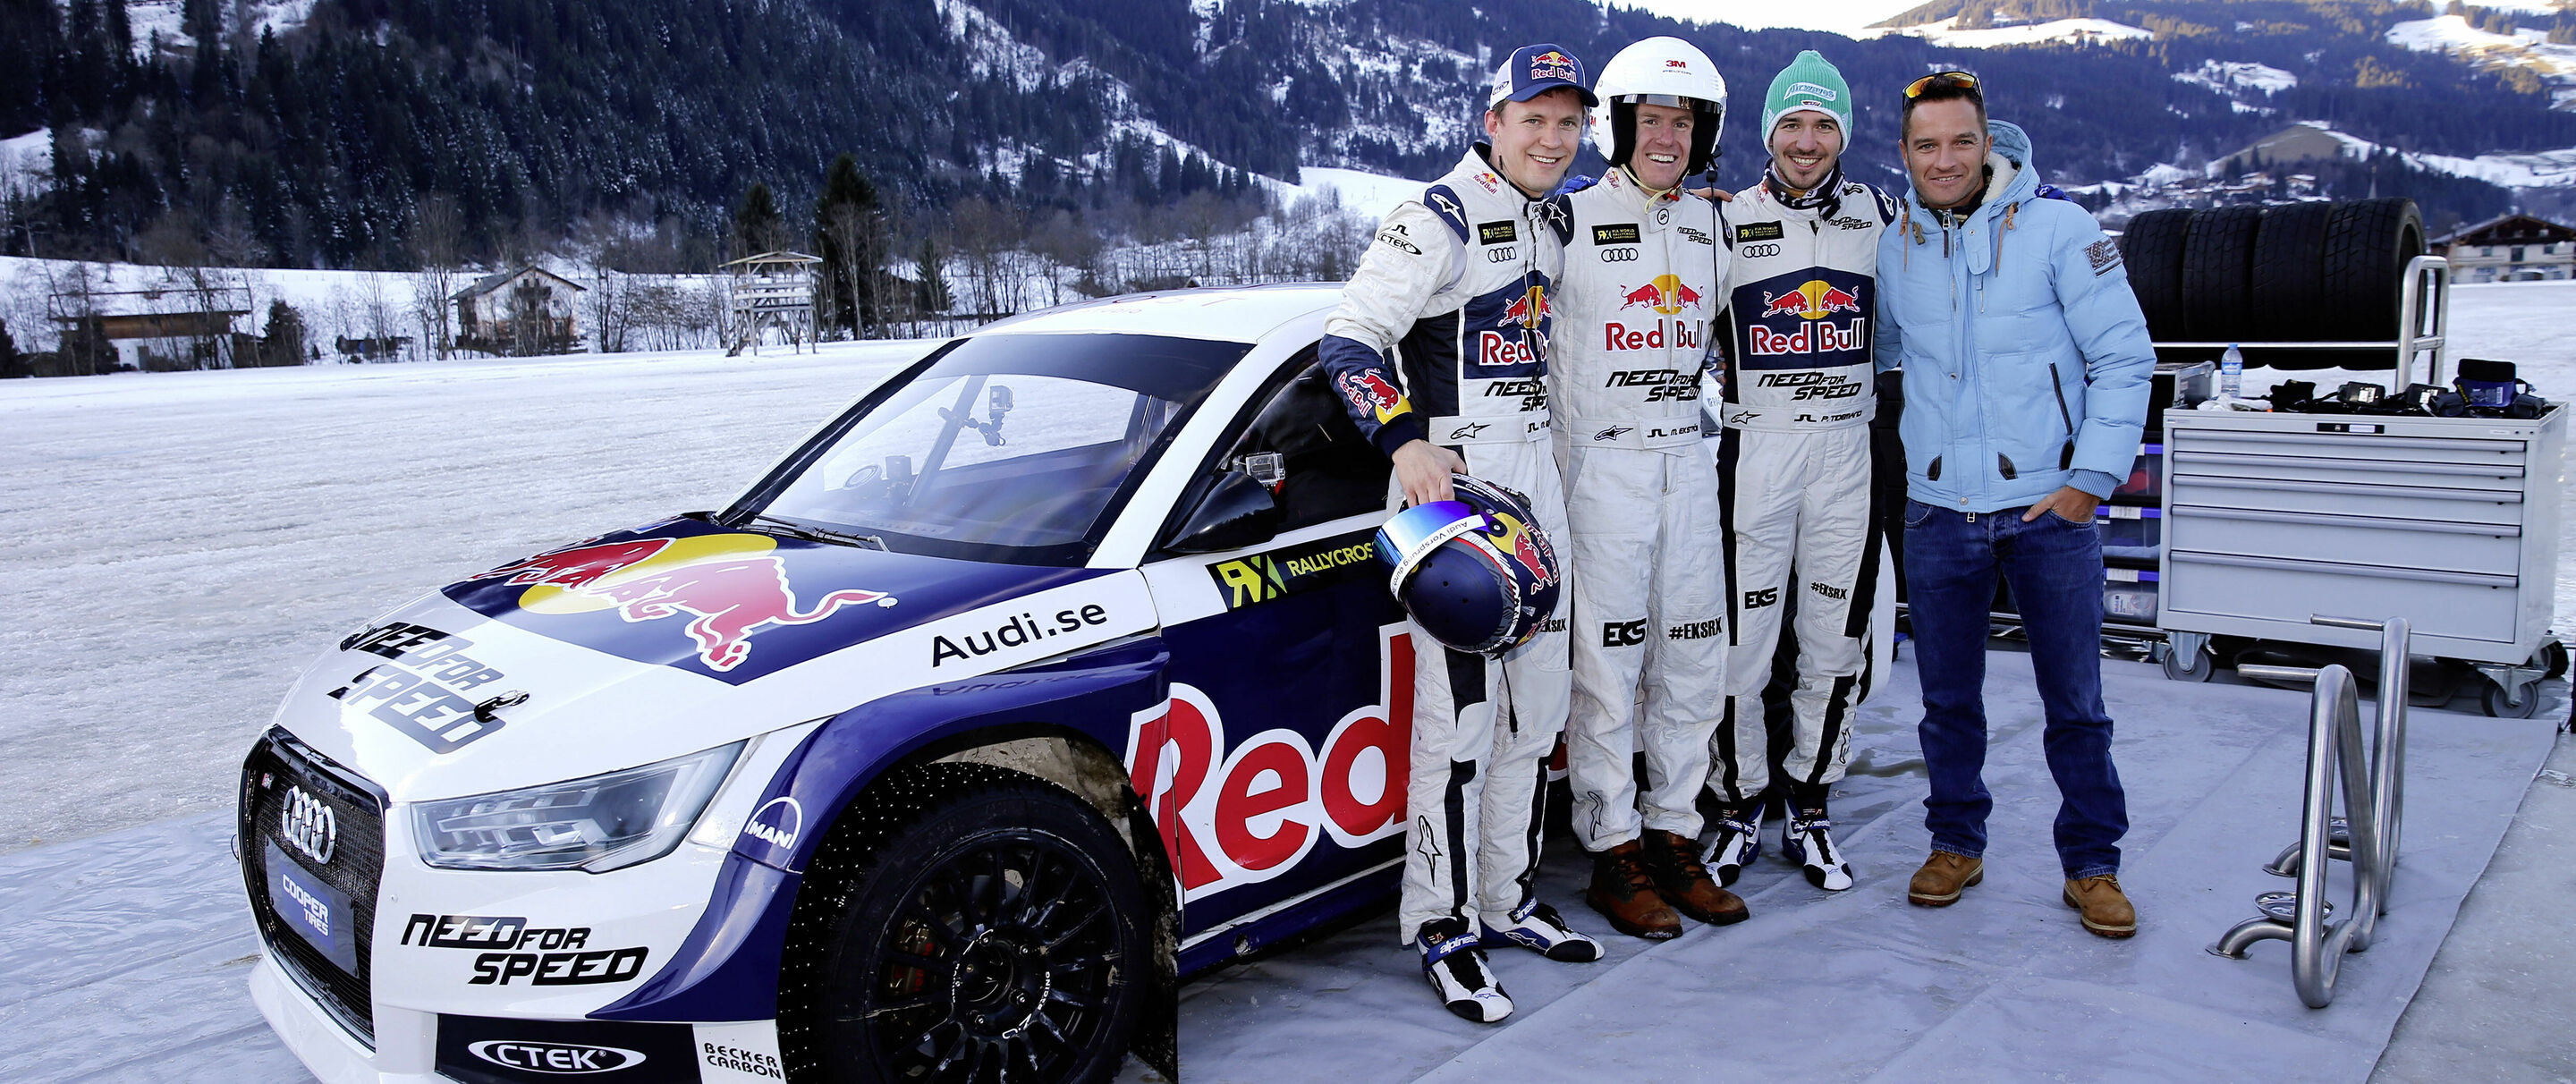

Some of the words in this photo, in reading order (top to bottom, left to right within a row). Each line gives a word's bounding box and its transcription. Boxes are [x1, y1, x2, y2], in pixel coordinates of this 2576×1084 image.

[1532, 66, 1556, 80] Red
[1556, 67, 1578, 83] Bull
[1665, 59, 1686, 68] 3M
[1473, 174, 1487, 187] Red
[1485, 182, 1497, 194] Bull
[1677, 226, 1697, 234] NEED
[1841, 222, 1872, 230] SPEED
[1688, 235, 1712, 245] SPEED
[1481, 330, 1535, 364] Red
[1605, 318, 1665, 351] Red
[1676, 319, 1704, 349] Bull
[1750, 322, 1809, 353] Red
[1819, 319, 1864, 351] Bull
[1484, 381, 1542, 396] NEED
[1606, 369, 1679, 387] NEED
[1758, 372, 1824, 387] NEED
[1819, 376, 1847, 385] FOR
[1338, 371, 1357, 400] Red
[1352, 391, 1372, 418] Bull
[1791, 383, 1862, 401] SPEED
[1447, 521, 1468, 535] Audi
[1286, 542, 1375, 577] RALLYCROS
[1403, 533, 1446, 566] Vorsprung
[1744, 587, 1778, 610] EKS
[1810, 581, 1848, 600] #EKSRX
[933, 604, 1107, 668] Audi.se
[1602, 618, 1647, 648] EKS
[1668, 616, 1723, 640] #EKSRX
[352, 622, 475, 667] NEED
[416, 653, 504, 691] FOR
[329, 664, 507, 755] SPEED
[1129, 629, 1417, 894] Red
[748, 821, 792, 848] MAN
[283, 874, 329, 924] COOPER
[303, 908, 329, 936] TIRES
[401, 915, 527, 950] NEED
[516, 927, 591, 951] FOR
[468, 946, 649, 986] SPEED
[704, 1042, 778, 1068] BECKER
[707, 1055, 782, 1080] CARBON
